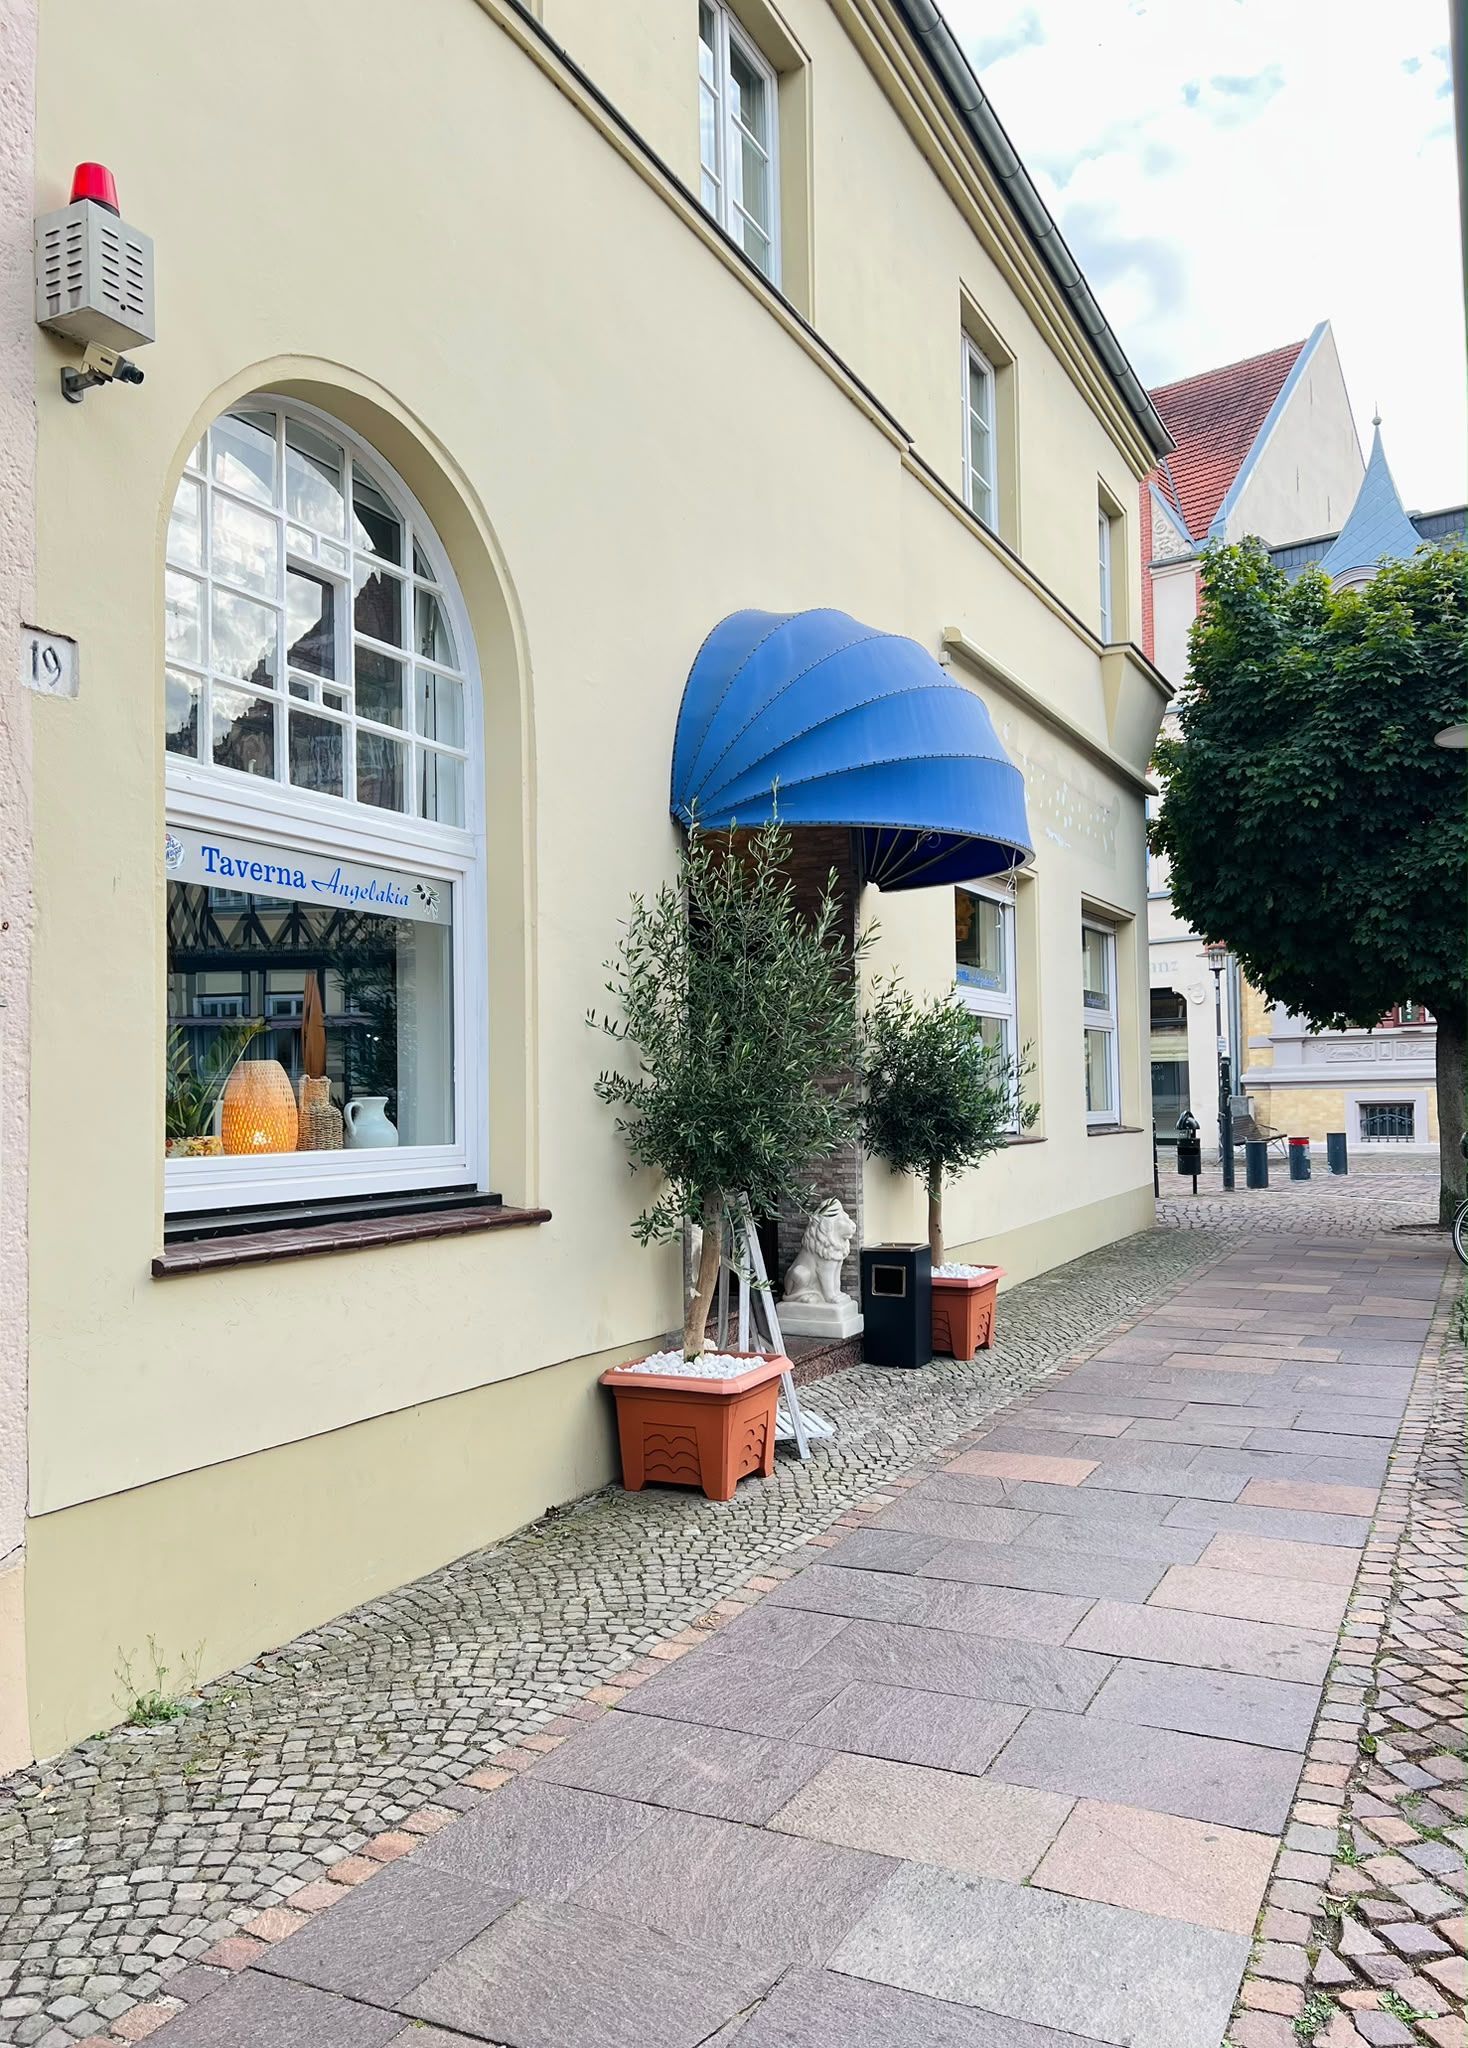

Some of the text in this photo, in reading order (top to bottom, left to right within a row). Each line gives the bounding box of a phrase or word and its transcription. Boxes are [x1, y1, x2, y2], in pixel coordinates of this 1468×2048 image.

[31, 640, 62, 686] 19
[201, 845, 307, 889] Taverna
[310, 867, 409, 906] Angelakia
